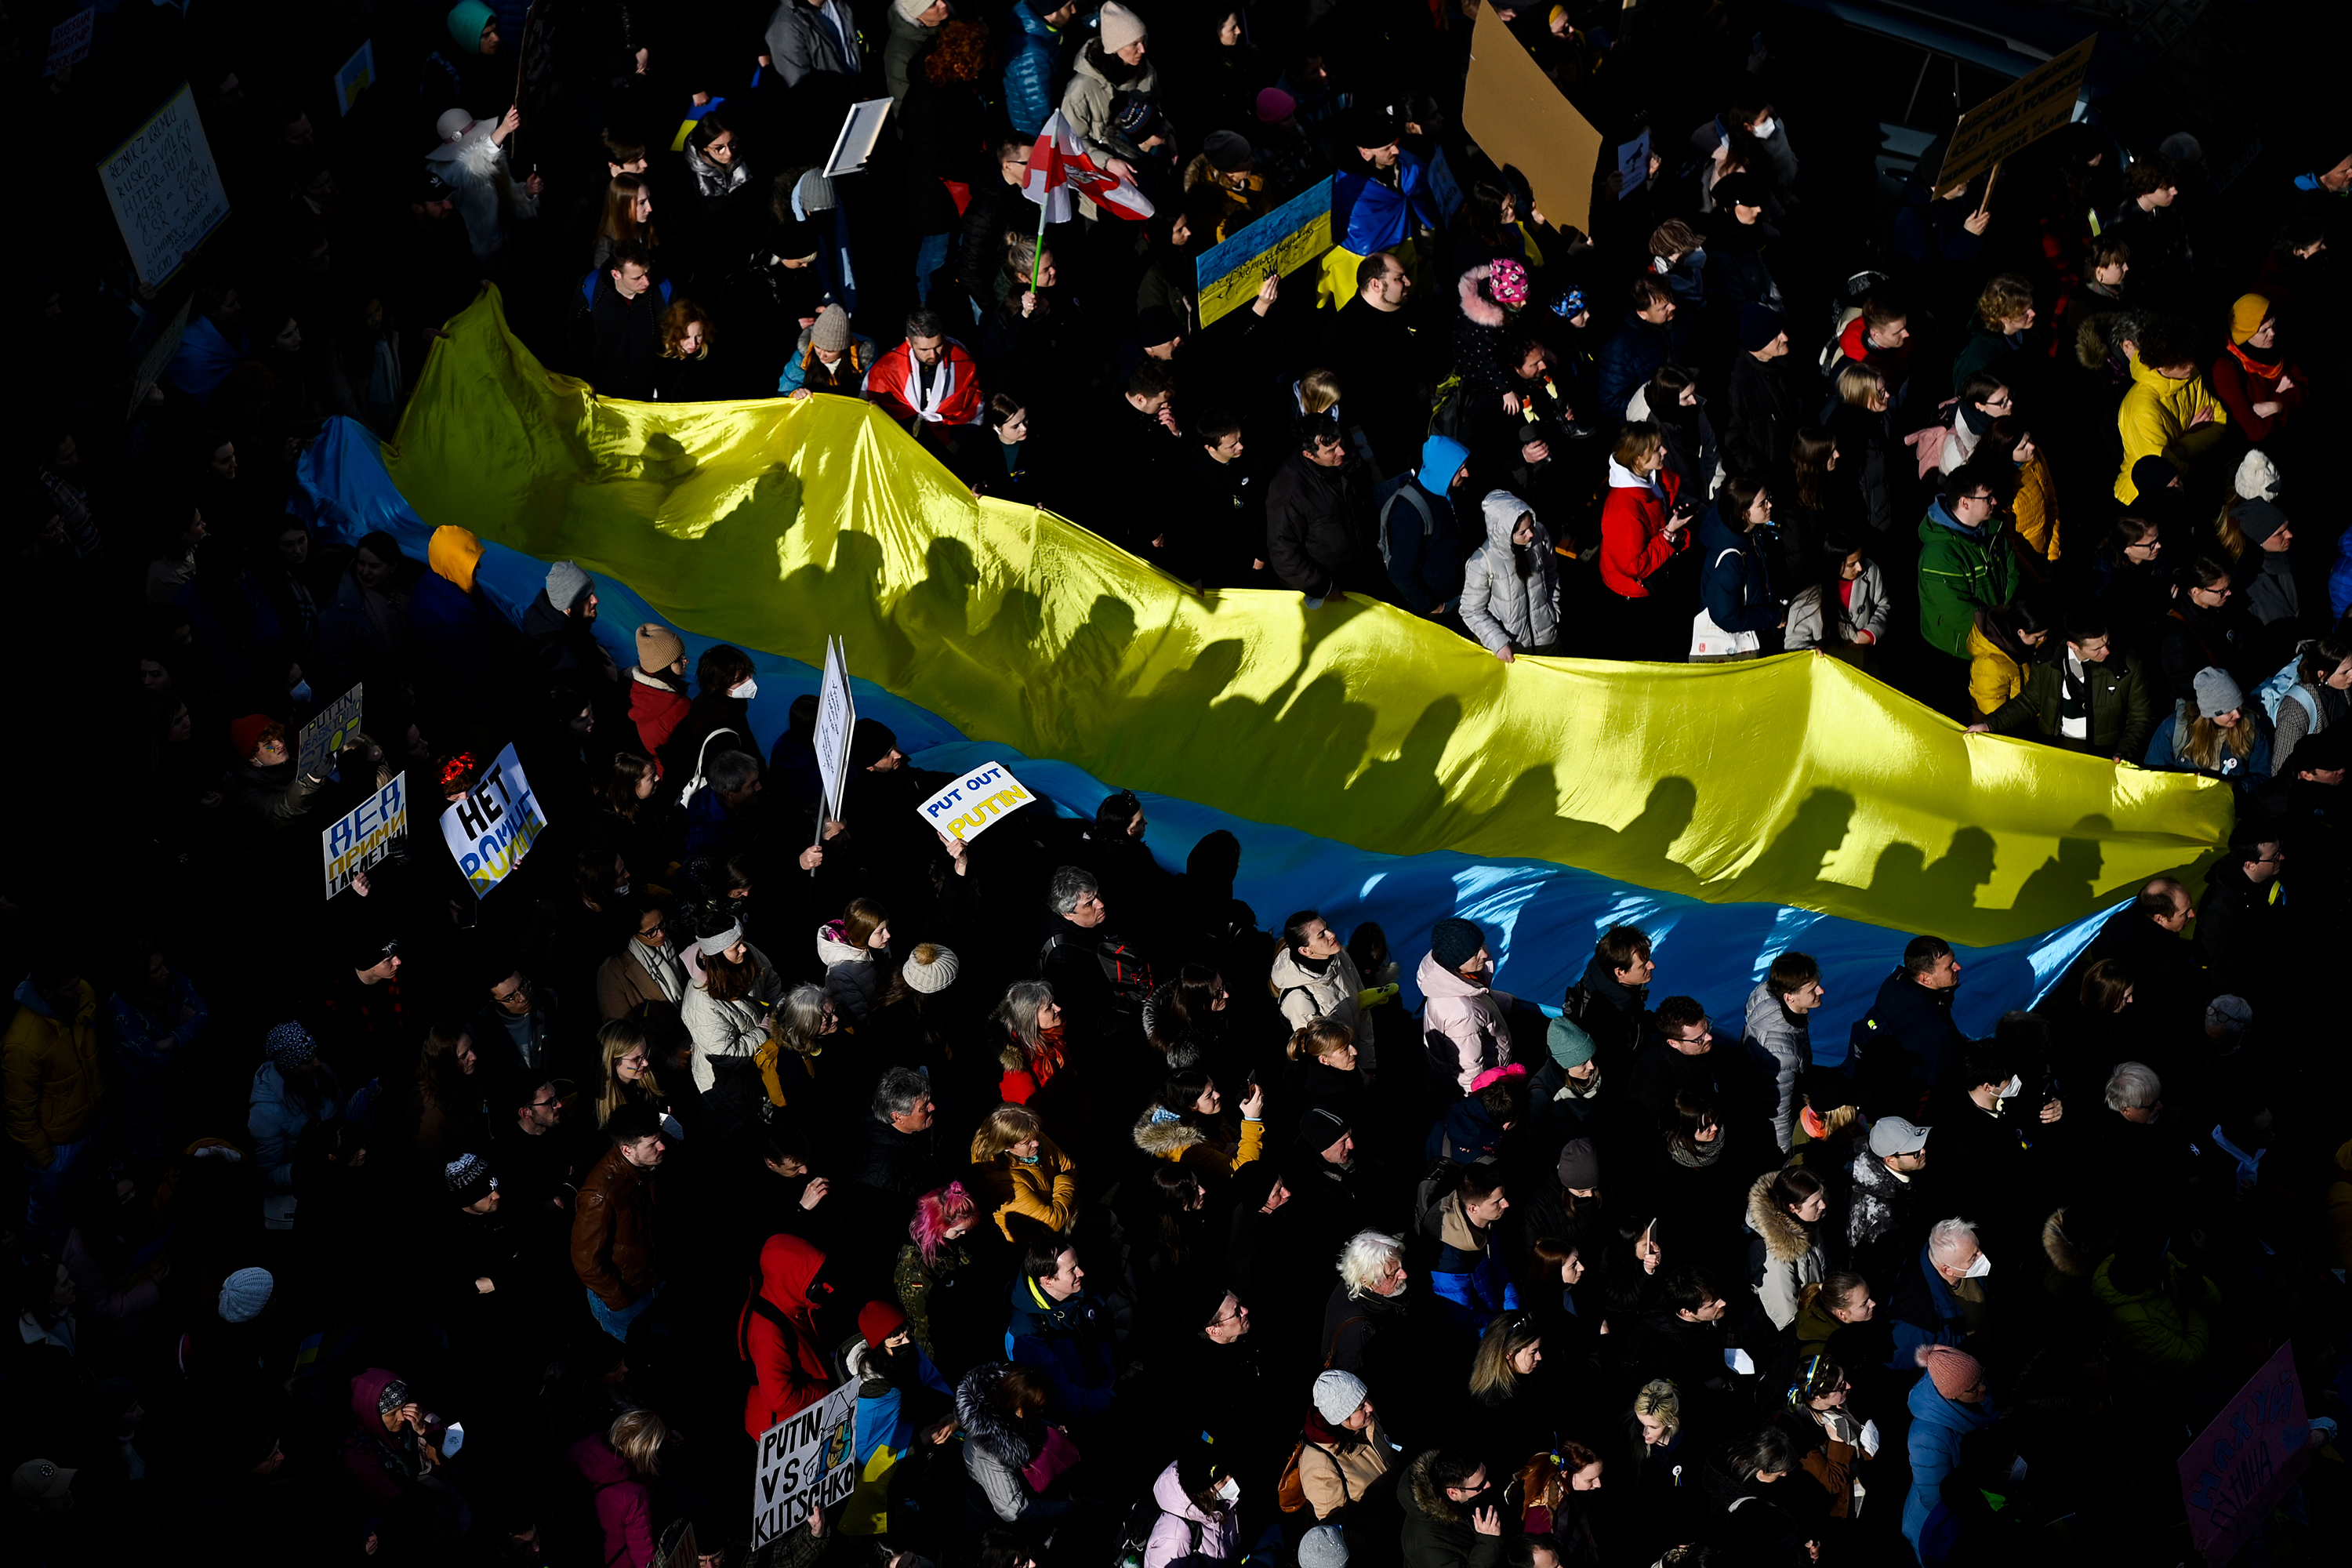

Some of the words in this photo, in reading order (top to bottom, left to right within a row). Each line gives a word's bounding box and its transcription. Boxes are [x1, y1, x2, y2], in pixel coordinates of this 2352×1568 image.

[49, 25, 89, 56] WARSHIP
[54, 10, 90, 40] RUSSIAN
[44, 53, 71, 73] FUCK
[71, 42, 89, 61] OFF
[1957, 89, 2018, 138] RUSSIAN
[2022, 51, 2082, 96] WARSHIP
[136, 136, 148, 154] Z
[147, 104, 177, 144] KREMLU
[1951, 132, 1979, 158] GO
[1979, 107, 2020, 143] FUCK
[2032, 107, 2073, 138] ISLAND
[116, 160, 151, 198] RUSKO
[156, 118, 191, 160] VÁLKA
[184, 163, 213, 205] KRYM
[136, 194, 162, 229] 1938
[176, 157, 199, 190] 2014
[147, 256, 172, 282] RUSKO
[298, 713, 361, 779] STOP
[456, 762, 511, 842] НЕТ
[927, 788, 963, 818] PUT
[966, 768, 1002, 791] OUT
[947, 785, 1028, 840] PUTIN
[328, 809, 405, 880] ПРИМИ
[762, 1405, 824, 1471] PUTIN
[754, 1461, 855, 1551] KLITSCHKO
[761, 1457, 800, 1505] VS
[2210, 1439, 2274, 1533] ПУТИНА
